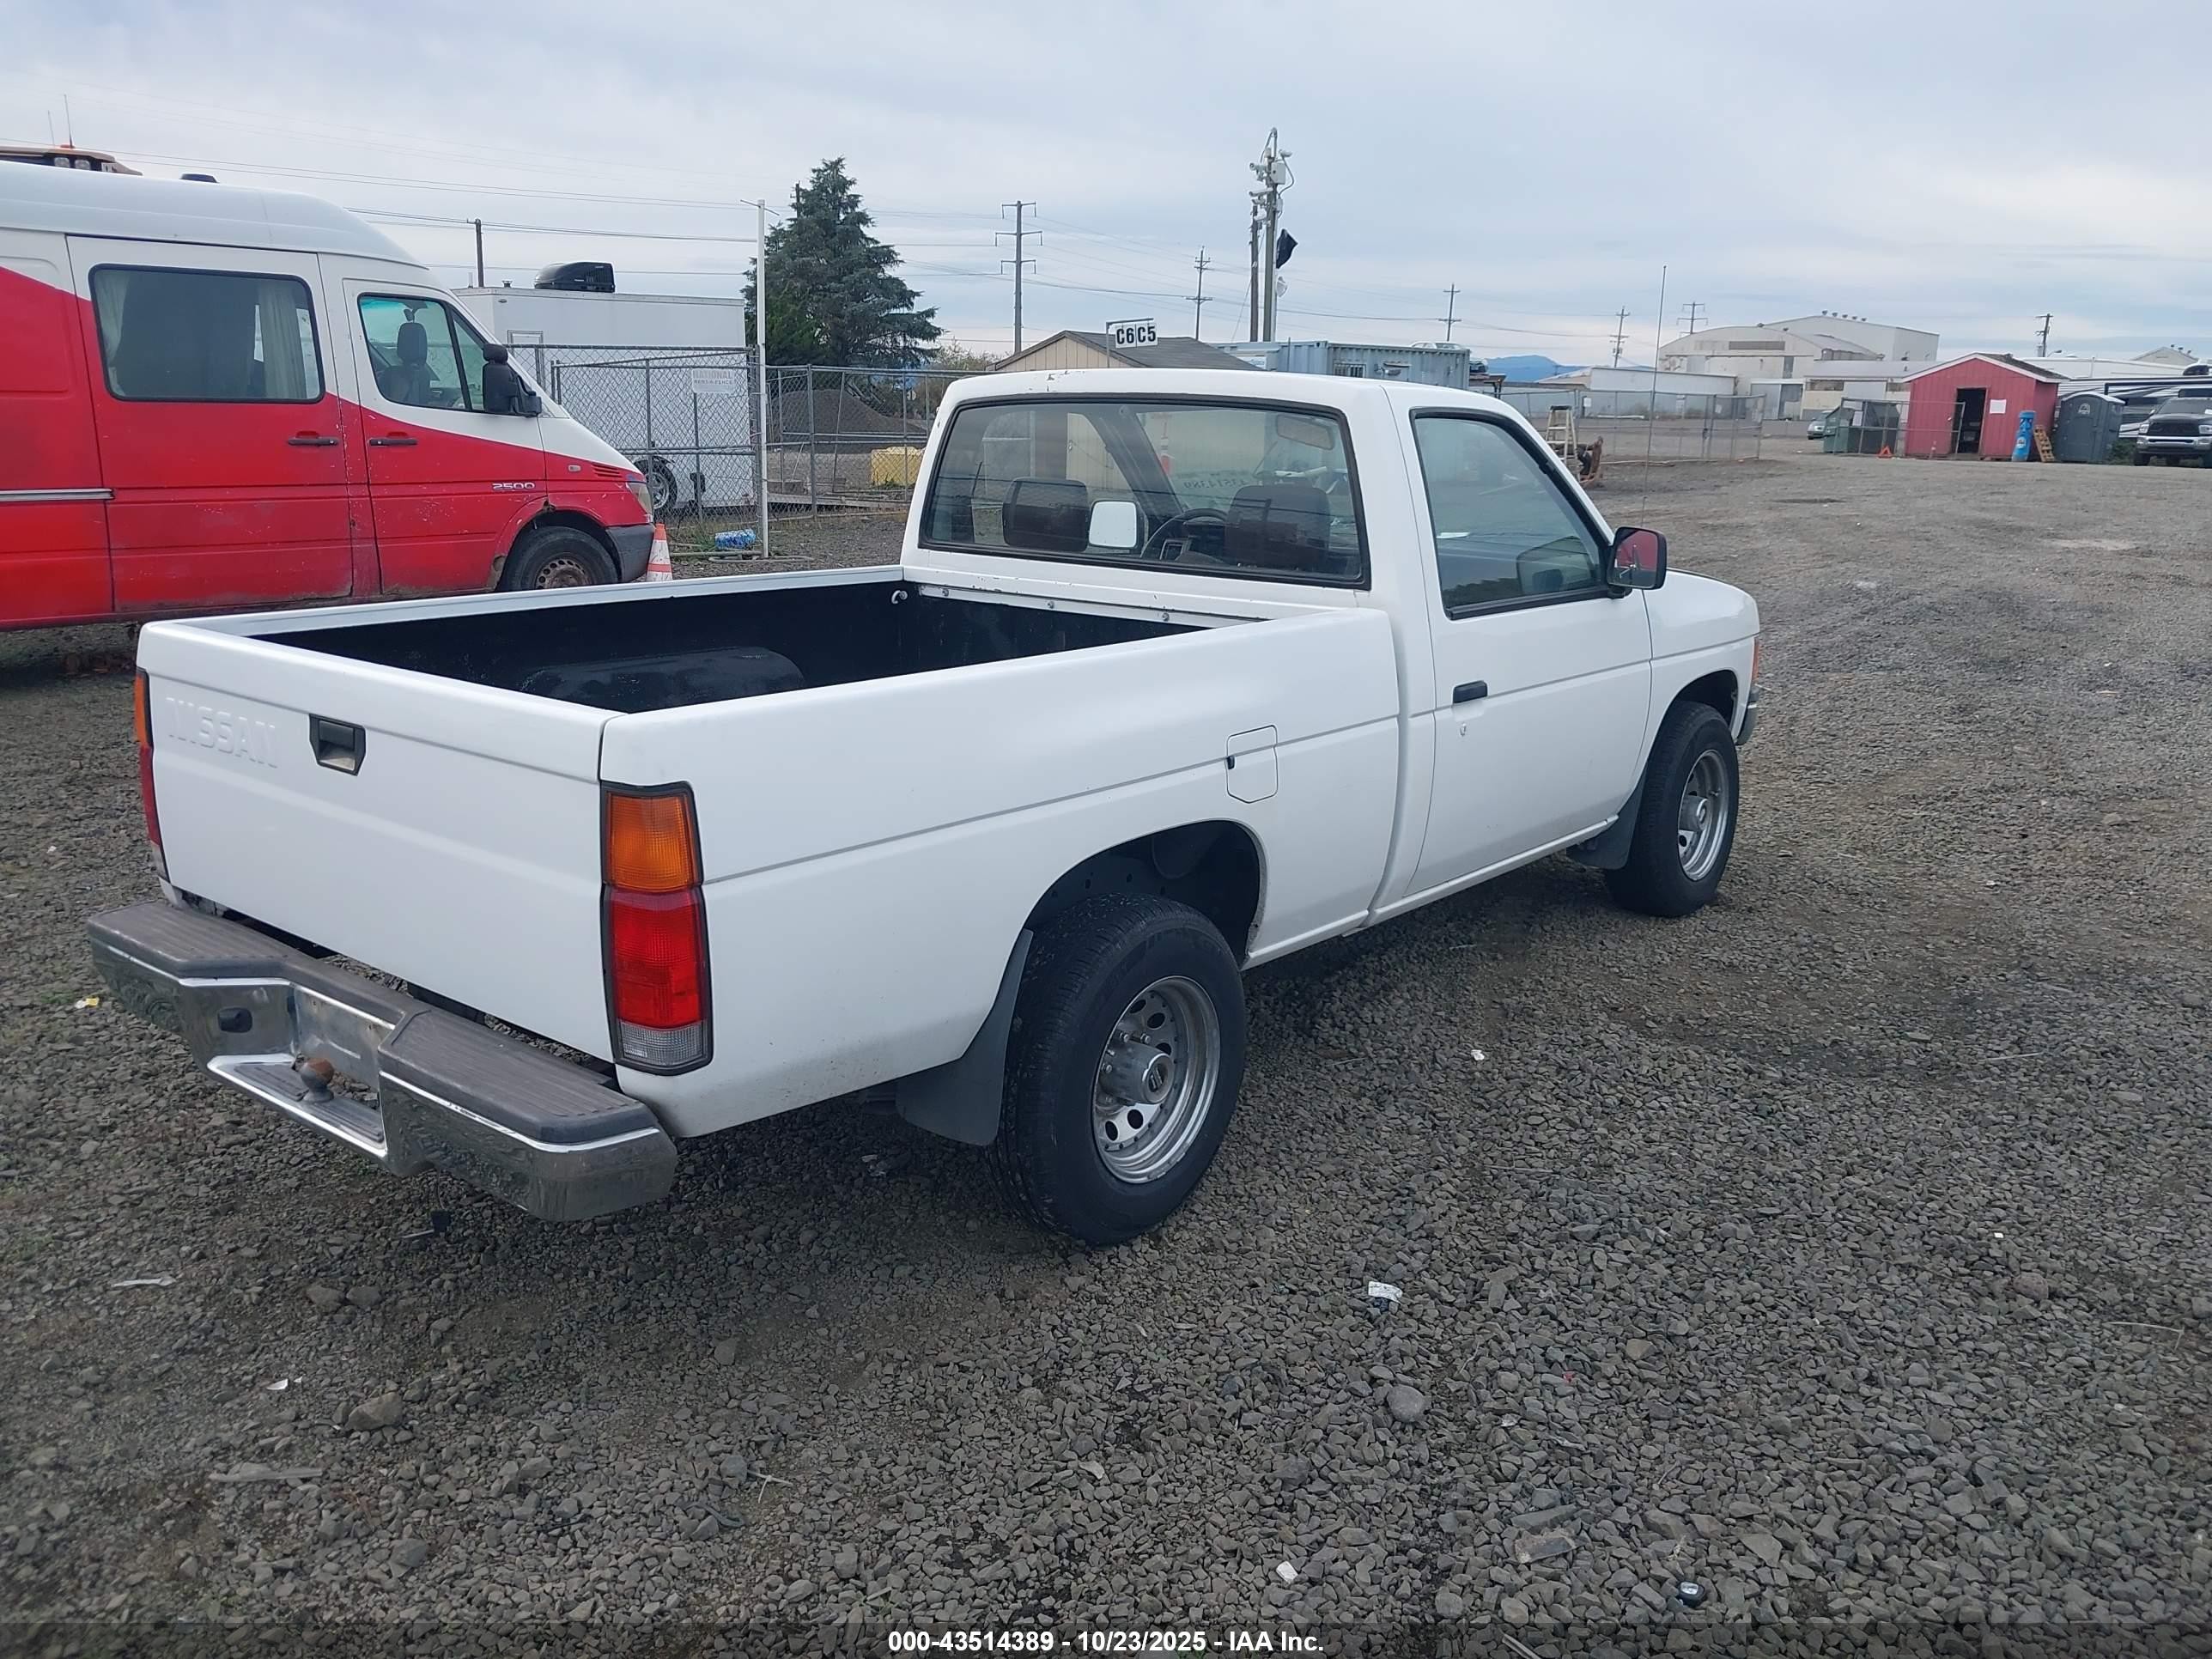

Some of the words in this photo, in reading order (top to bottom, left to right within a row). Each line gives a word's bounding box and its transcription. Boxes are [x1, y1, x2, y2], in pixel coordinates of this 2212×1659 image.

[1116, 327, 1134, 345] C6
[1138, 325, 1157, 343] C5
[692, 369, 732, 380] NATIONAL
[492, 482, 535, 490] 2500
[166, 696, 278, 769] NISSAN
